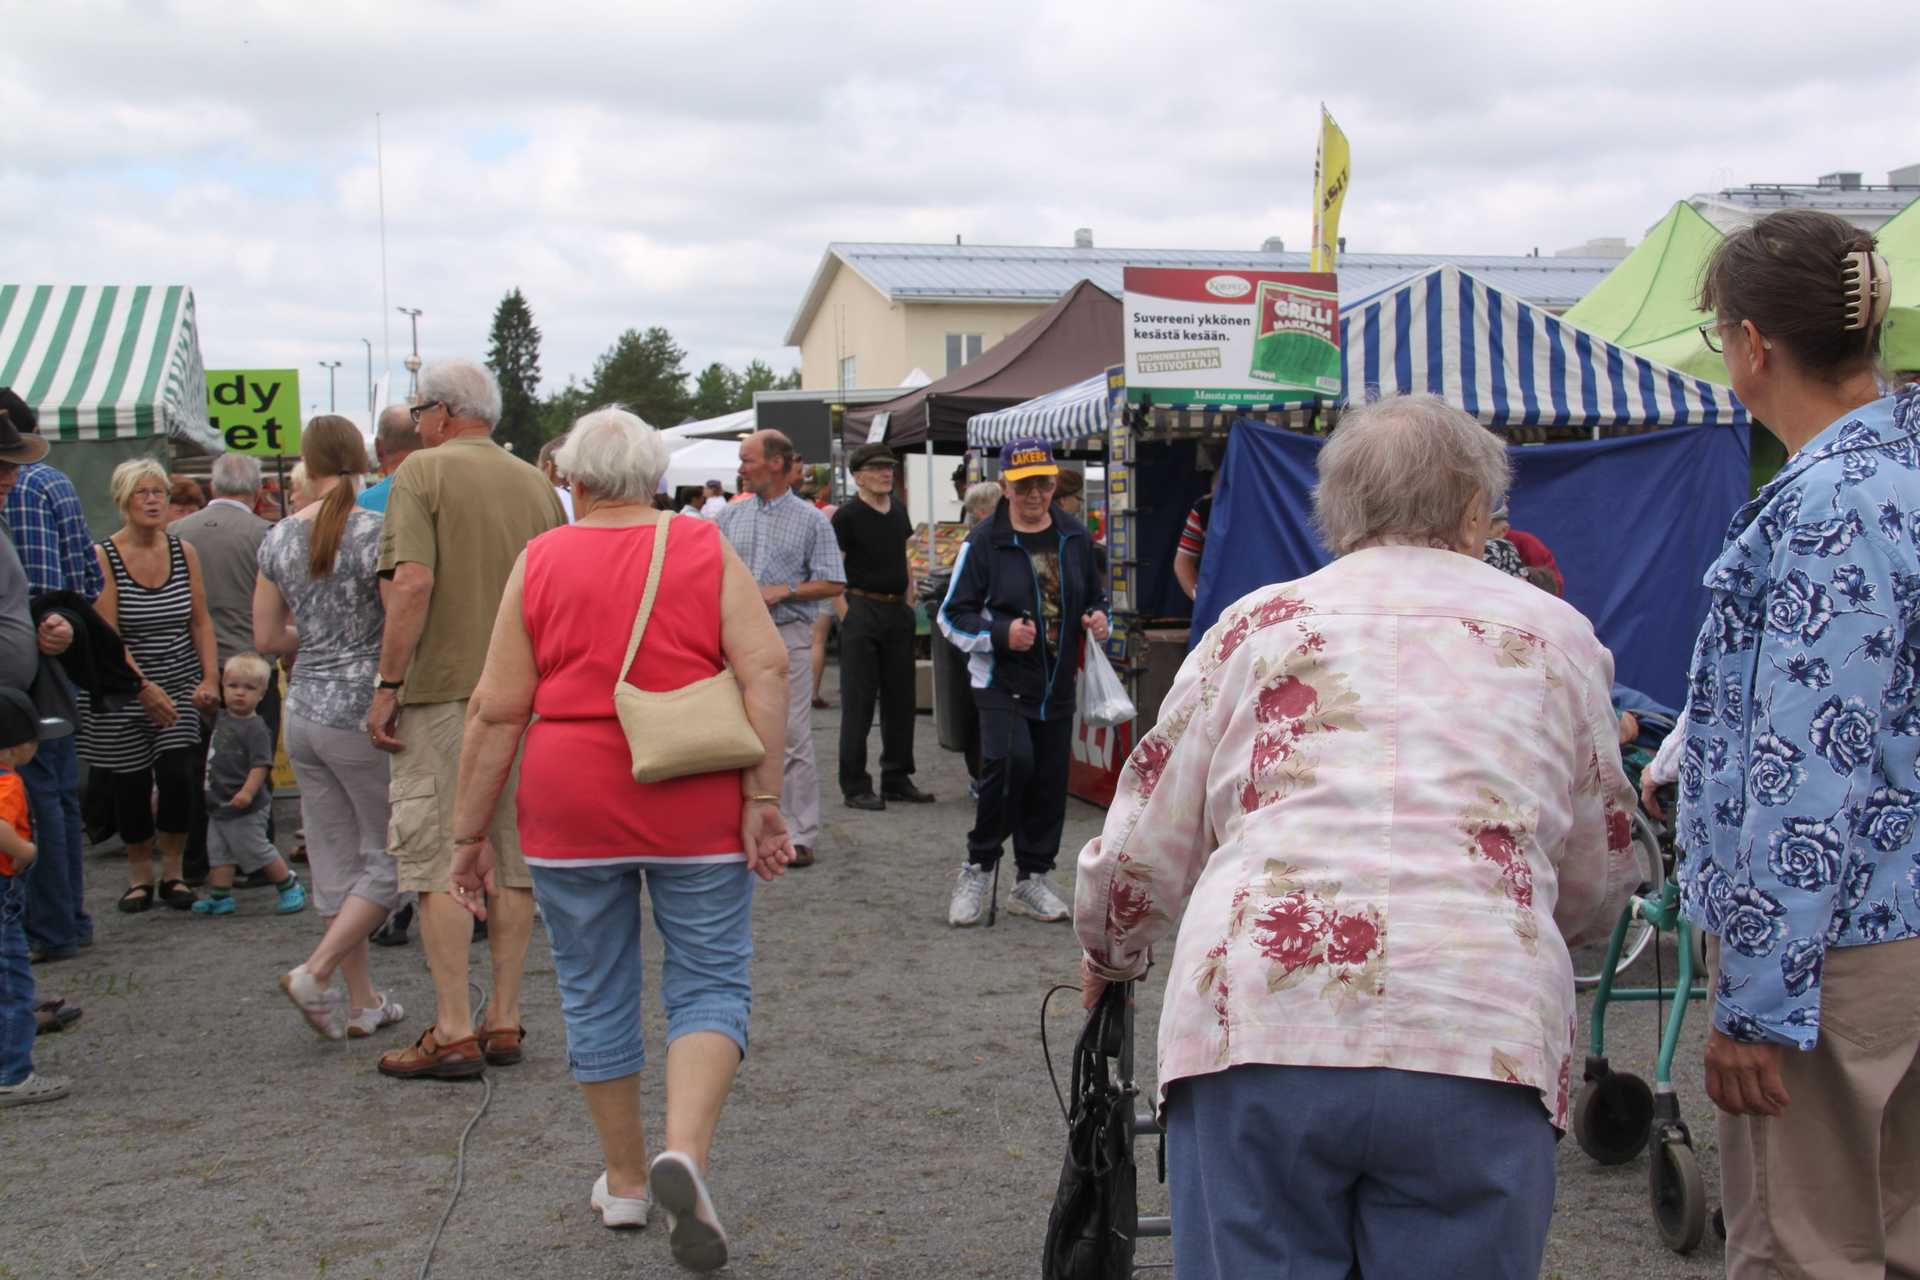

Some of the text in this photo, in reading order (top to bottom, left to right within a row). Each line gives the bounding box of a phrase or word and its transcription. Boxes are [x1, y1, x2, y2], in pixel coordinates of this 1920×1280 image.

[1133, 312, 1251, 328] Suvereeni ykkönen
[1274, 300, 1332, 325] GRILLI
[1133, 328, 1230, 342] kesästä kesään.
[1273, 320, 1332, 340] MAKKARA
[1138, 350, 1219, 362] MONINKERTAINEN
[1140, 359, 1220, 373] TESTIVOITTAJA
[207, 374, 281, 413] dy
[1011, 450, 1047, 466] LAKERS
